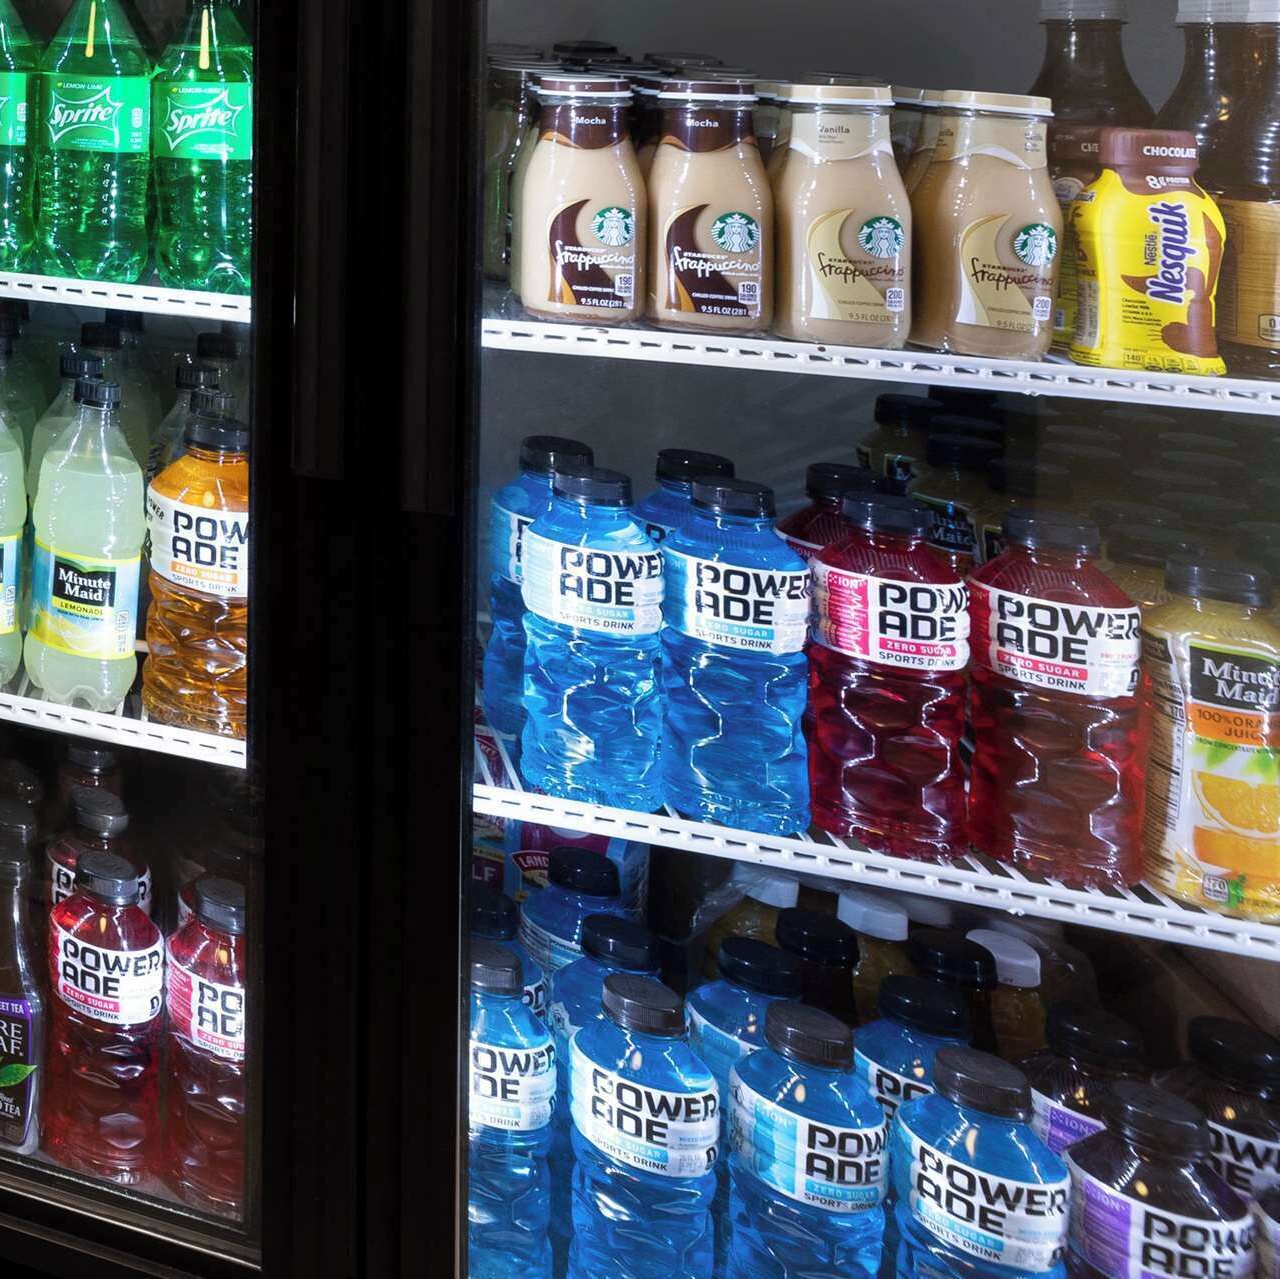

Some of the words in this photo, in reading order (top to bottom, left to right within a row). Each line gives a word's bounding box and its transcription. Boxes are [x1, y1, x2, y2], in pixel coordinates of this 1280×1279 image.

[52, 103, 114, 127] Sprite
[166, 108, 231, 130] Sprite
[575, 116, 607, 126] Mocha
[687, 119, 719, 128] Mocha
[1143, 145, 1197, 160] CHOCOLATE
[673, 246, 759, 278] frappuccino
[1146, 200, 1186, 304] Nesquik
[818, 252, 905, 288] frappuccino
[741, 283, 757, 294] 190
[887, 289, 903, 301] 200
[701, 305, 713, 313] 9.5
[713, 306, 721, 314] FL
[721, 306, 731, 315] OZ
[172, 535, 238, 570] ADE
[560, 547, 664, 581] POWER
[59, 567, 111, 590] Minute
[64, 583, 105, 602] Maid
[560, 573, 634, 607] ADE
[695, 561, 812, 599] POWER
[60, 601, 104, 616] LEMONADE
[695, 589, 775, 625] ADE
[997, 594, 1141, 641] POWER
[879, 610, 956, 642] ADE
[740, 638, 772, 649] DRINK
[886, 641, 916, 653] ZERO
[997, 622, 1089, 666] ADE
[62, 938, 162, 978] POWER
[62, 962, 120, 999] ADE
[592, 1067, 718, 1123] POWER
[591, 1095, 670, 1148] ADE
[919, 1146, 1066, 1217] POWER
[916, 1172, 1006, 1237] ADE
